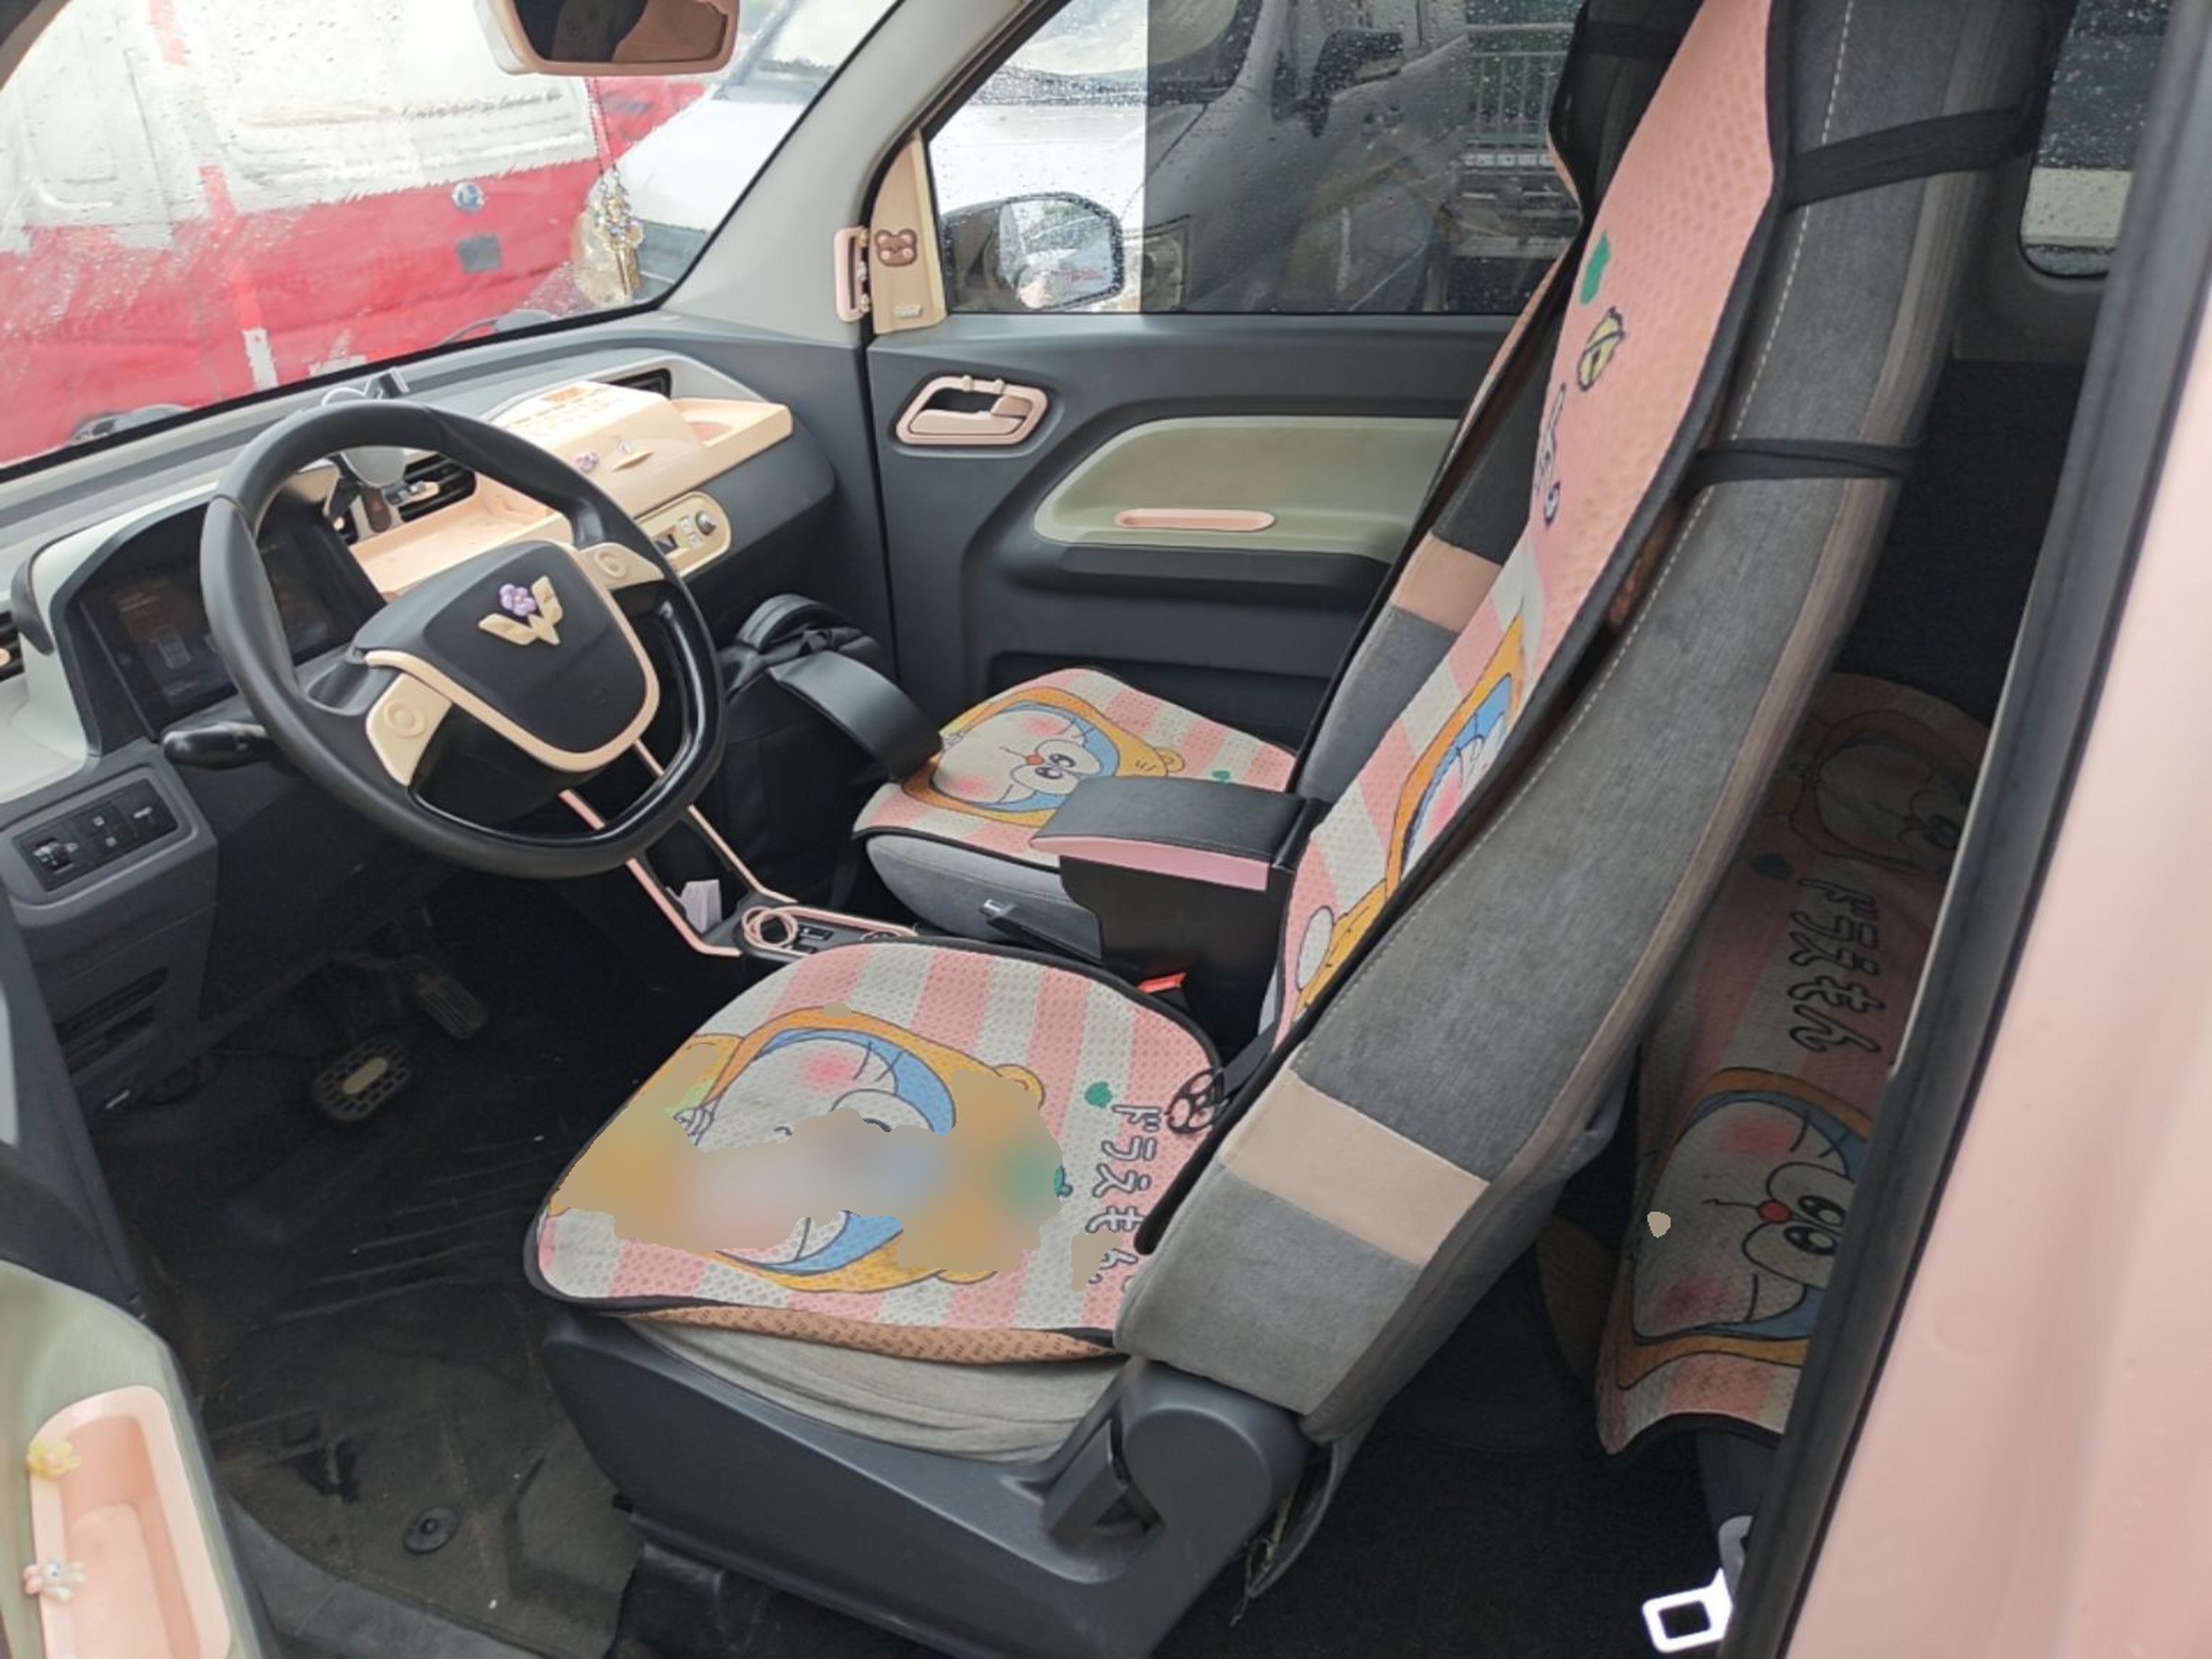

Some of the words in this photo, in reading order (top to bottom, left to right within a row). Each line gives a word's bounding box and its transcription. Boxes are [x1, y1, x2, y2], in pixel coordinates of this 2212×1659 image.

[1787, 877, 1890, 1053] ドラえもん
